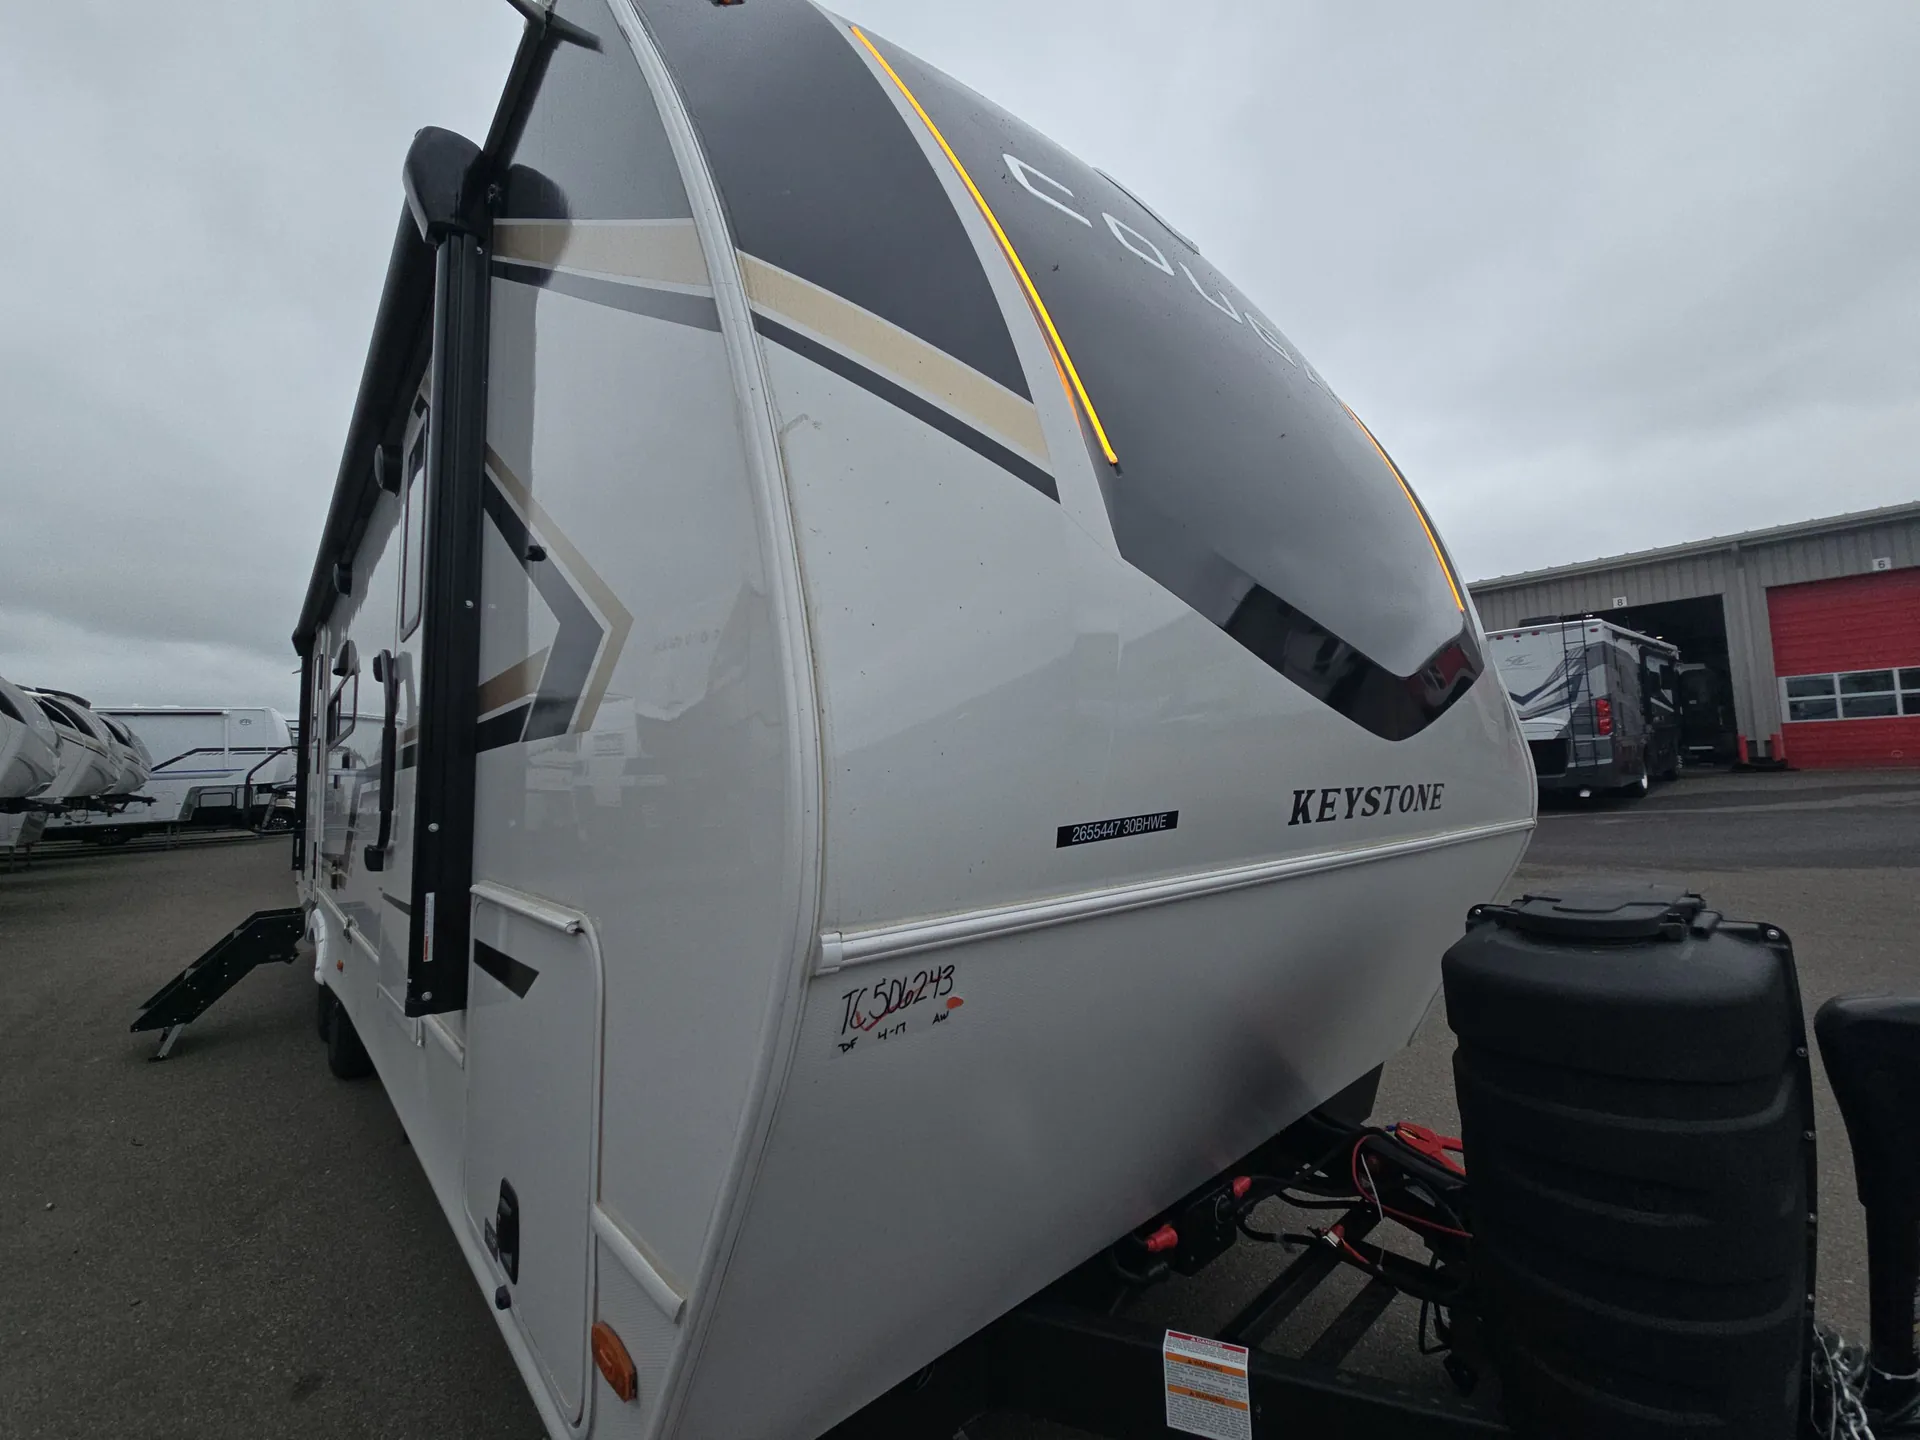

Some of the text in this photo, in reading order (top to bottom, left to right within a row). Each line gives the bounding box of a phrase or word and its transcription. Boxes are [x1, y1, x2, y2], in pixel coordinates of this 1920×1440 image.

[1288, 783, 1445, 826] KEYSTONE
[1072, 814, 1167, 842] 2655447 30BHWE
